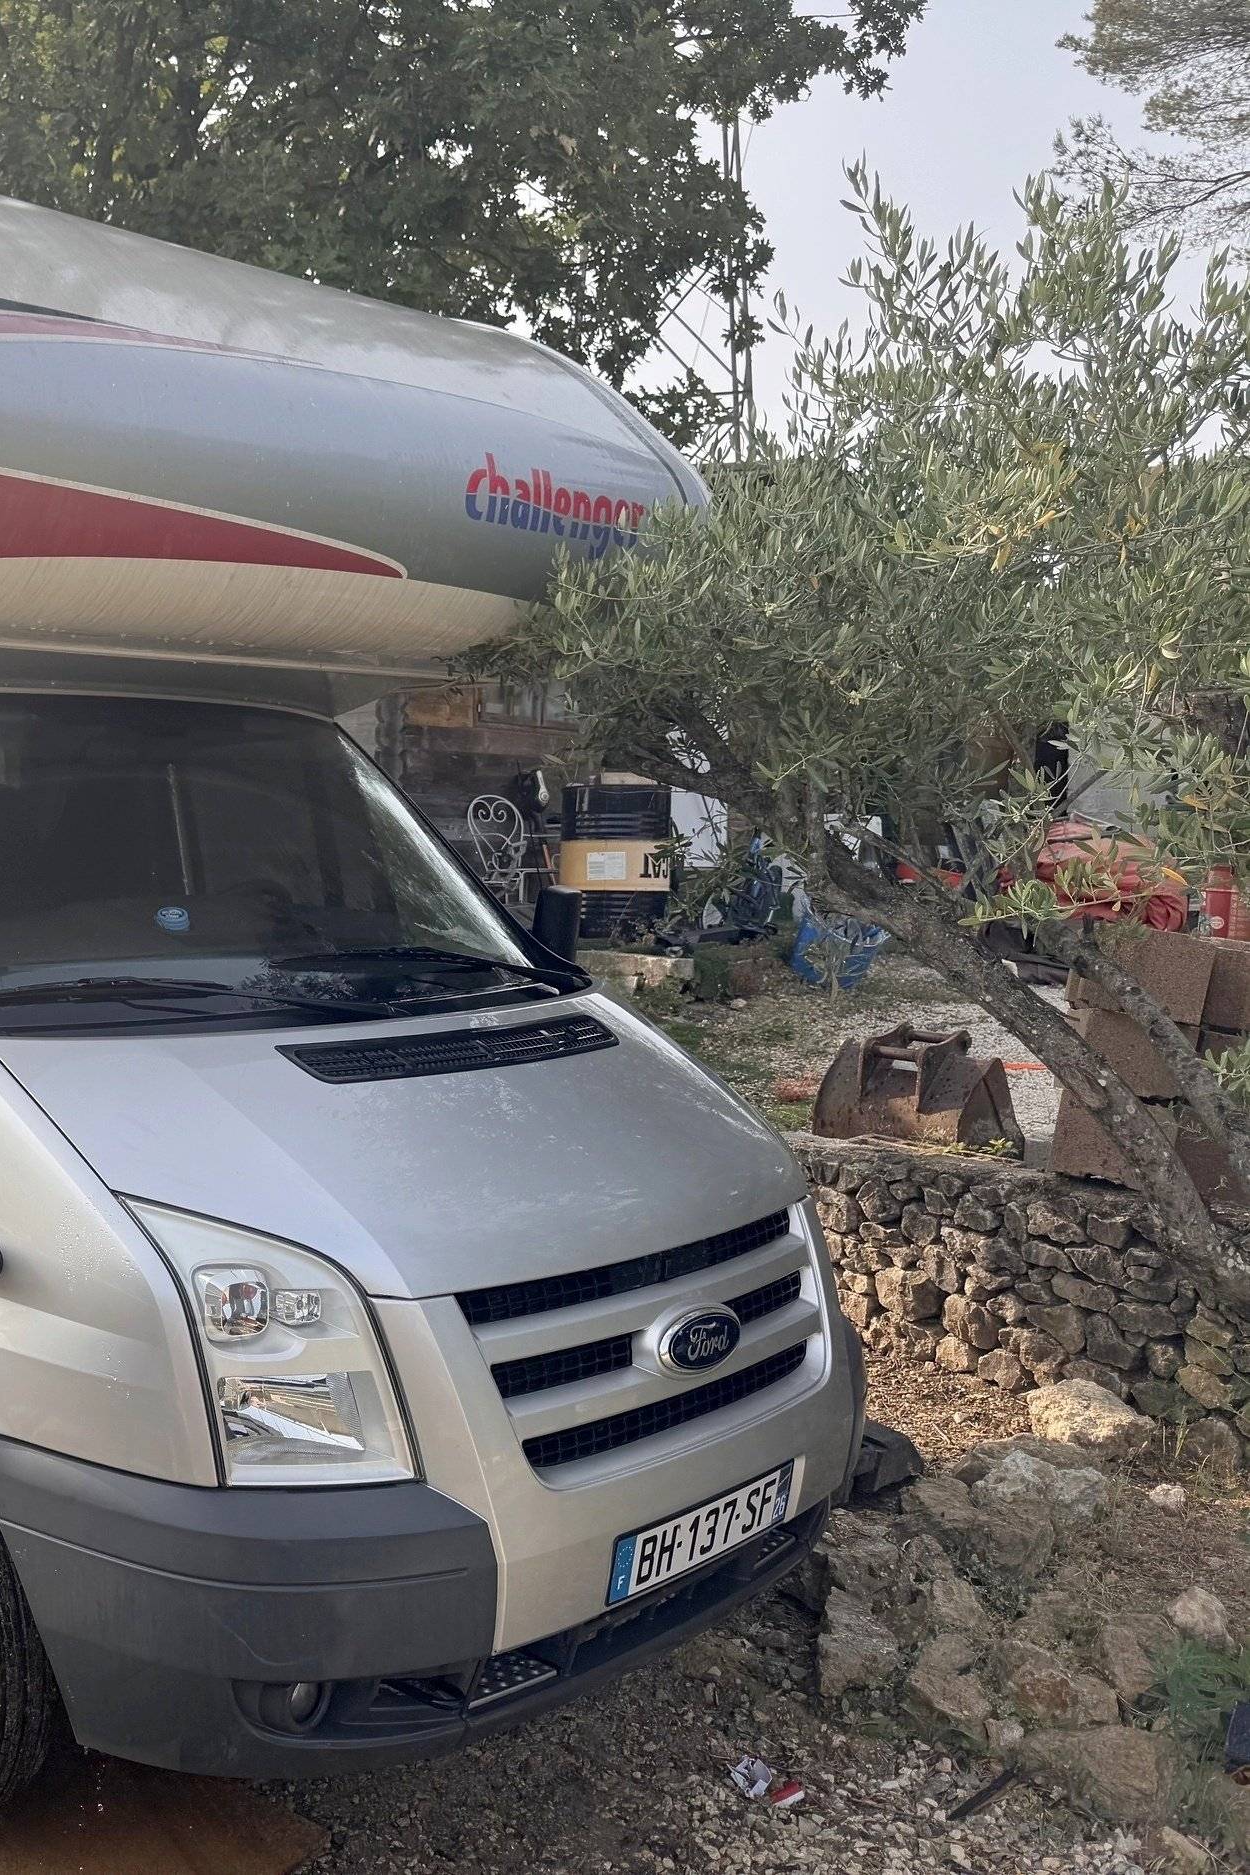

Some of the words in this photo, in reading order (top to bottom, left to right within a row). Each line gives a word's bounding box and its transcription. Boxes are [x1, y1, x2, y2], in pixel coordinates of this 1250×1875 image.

[688, 1322, 730, 1361] Ford
[616, 1575, 625, 1590] F
[772, 1497, 786, 1519] 26
